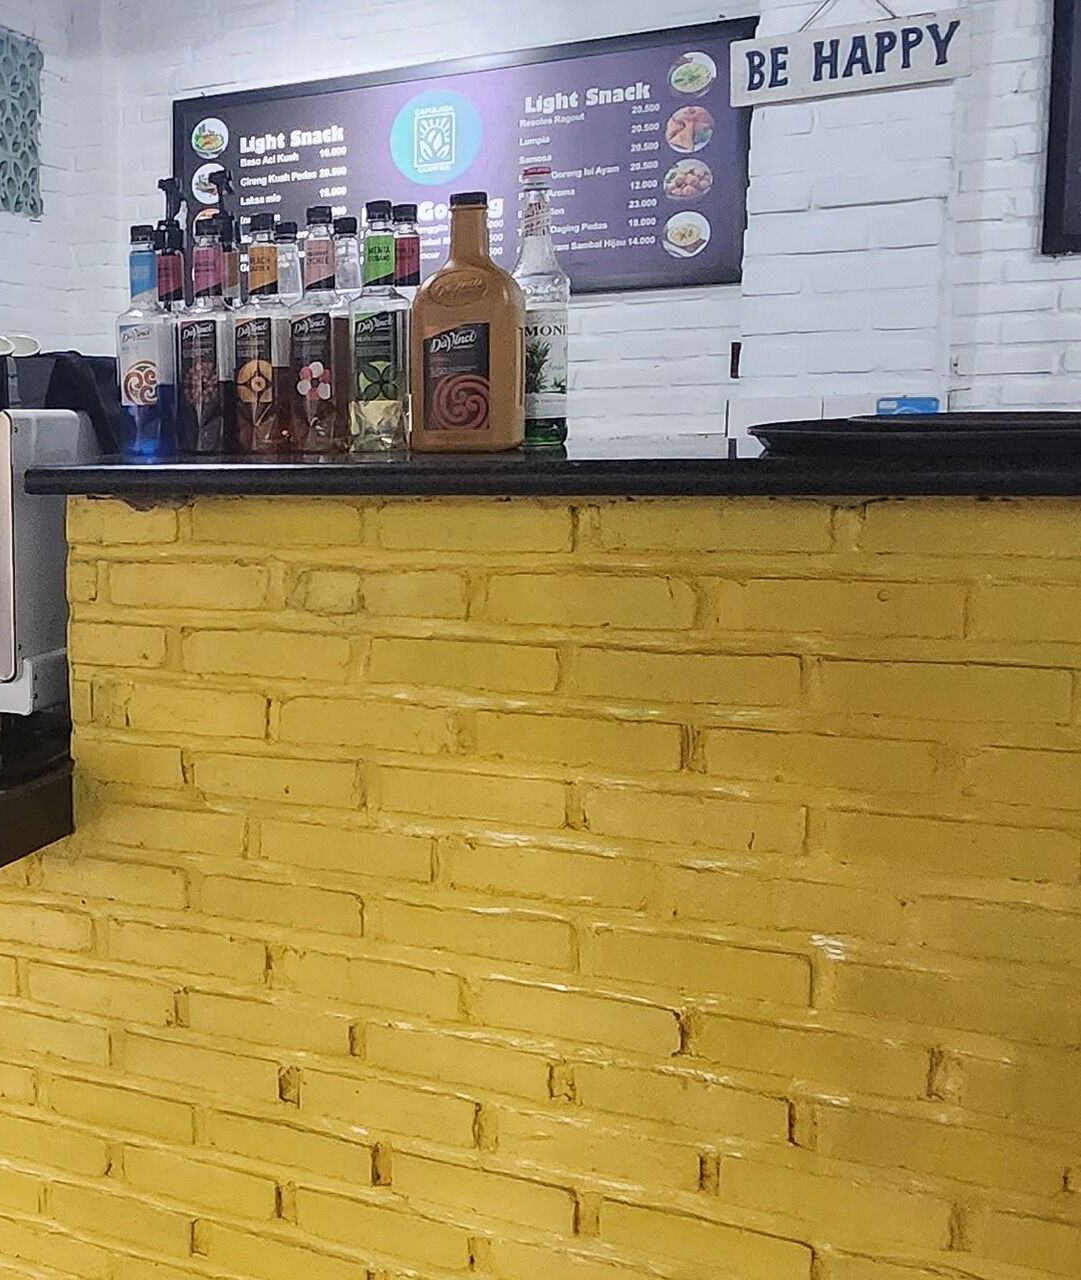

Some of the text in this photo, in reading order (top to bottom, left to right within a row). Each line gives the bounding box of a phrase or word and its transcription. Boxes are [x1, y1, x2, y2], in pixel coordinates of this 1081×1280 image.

[745, 20, 961, 91] BE HAPPY
[524, 82, 651, 115] Light Snack
[631, 103, 661, 114] 20.500
[240, 124, 345, 155] Light Snack
[519, 122, 660, 148] Lumpia 20.500
[519, 141, 659, 165] Samosa 20.500
[551, 169, 582, 180] Goreng
[595, 165, 620, 177] Ayam
[571, 239, 602, 251] Sambal
[525, 324, 566, 337] MONI
